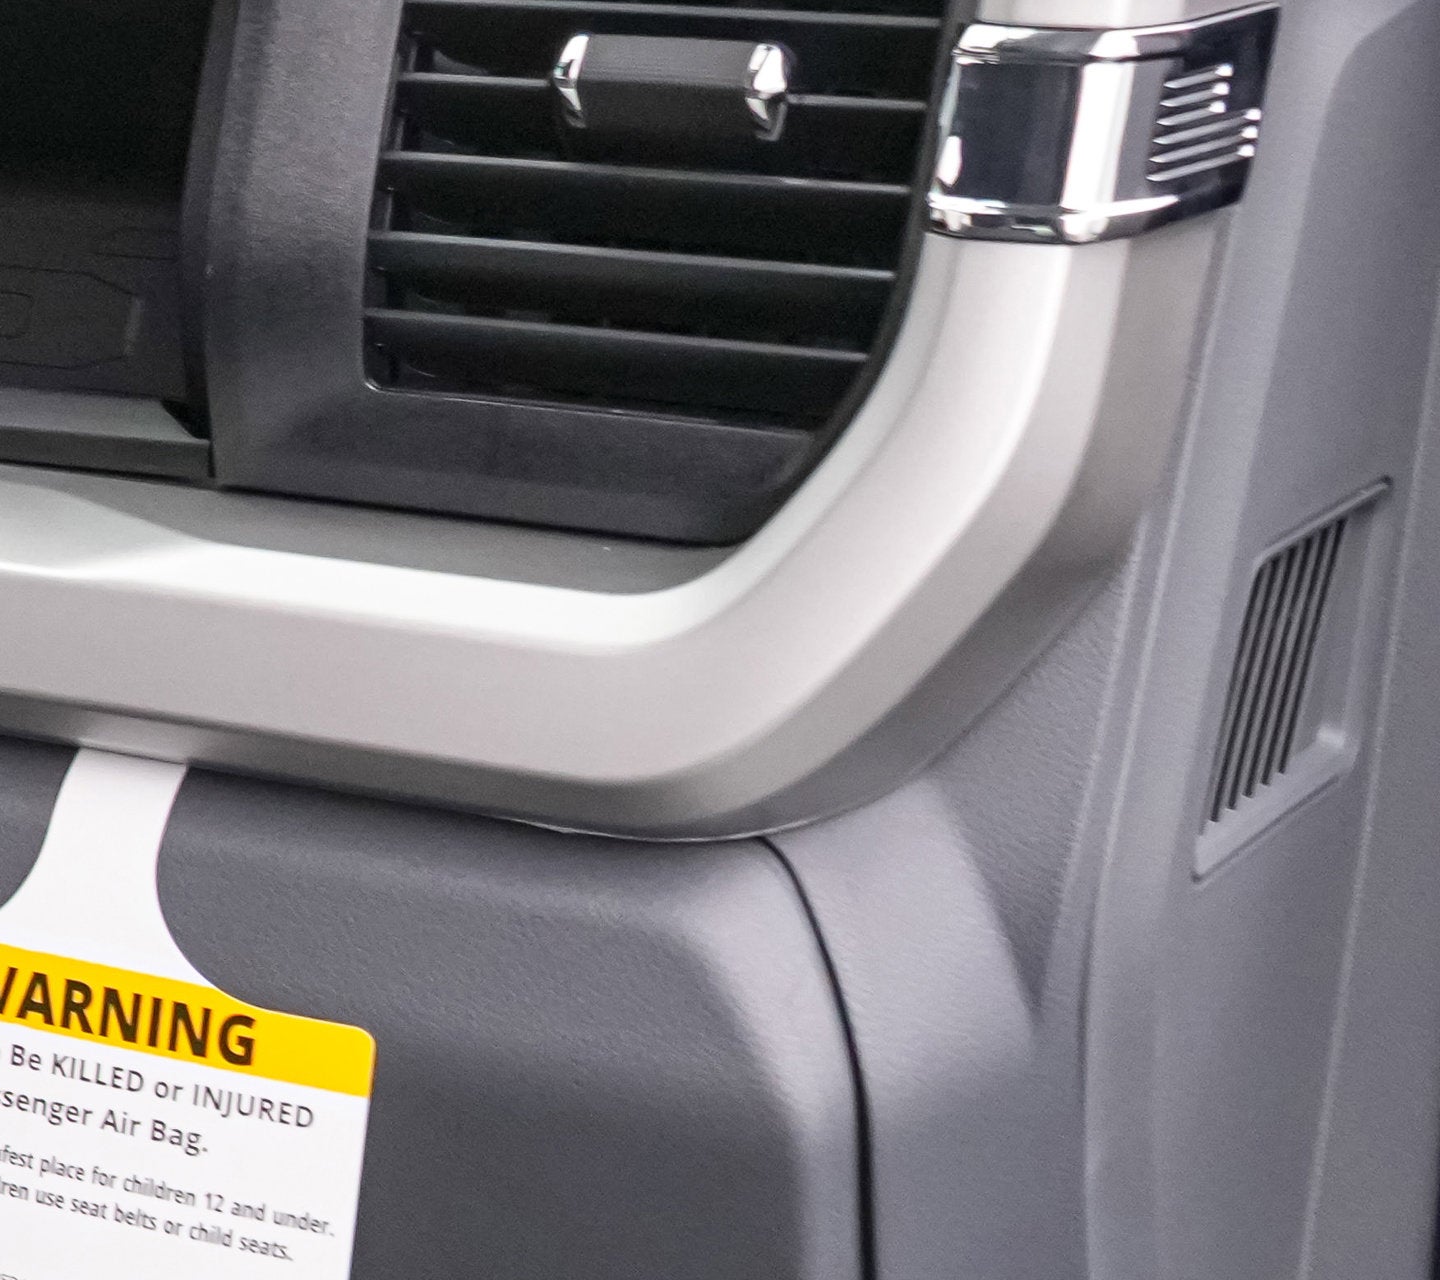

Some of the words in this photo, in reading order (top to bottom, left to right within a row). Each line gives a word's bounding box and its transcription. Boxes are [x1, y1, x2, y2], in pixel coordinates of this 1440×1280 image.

[11, 1044, 41, 1070] Be
[51, 1053, 144, 1093] KILLED
[154, 1080, 183, 1102] or
[193, 1083, 314, 1128] INJURED
[100, 1109, 141, 1136] Air
[151, 1119, 208, 1156] Bag.
[35, 1190, 64, 1209] use
[70, 1197, 108, 1220] seat
[114, 1203, 157, 1231] belts
[163, 1219, 182, 1236] or
[188, 1223, 233, 1248] child
[239, 1235, 294, 1261] seats.
[40, 1156, 85, 1182] place
[92, 1165, 116, 1189] for
[123, 1174, 196, 1207] children
[205, 1192, 224, 1213] 12
[230, 1201, 265, 1222] and
[273, 1210, 335, 1237] under.
